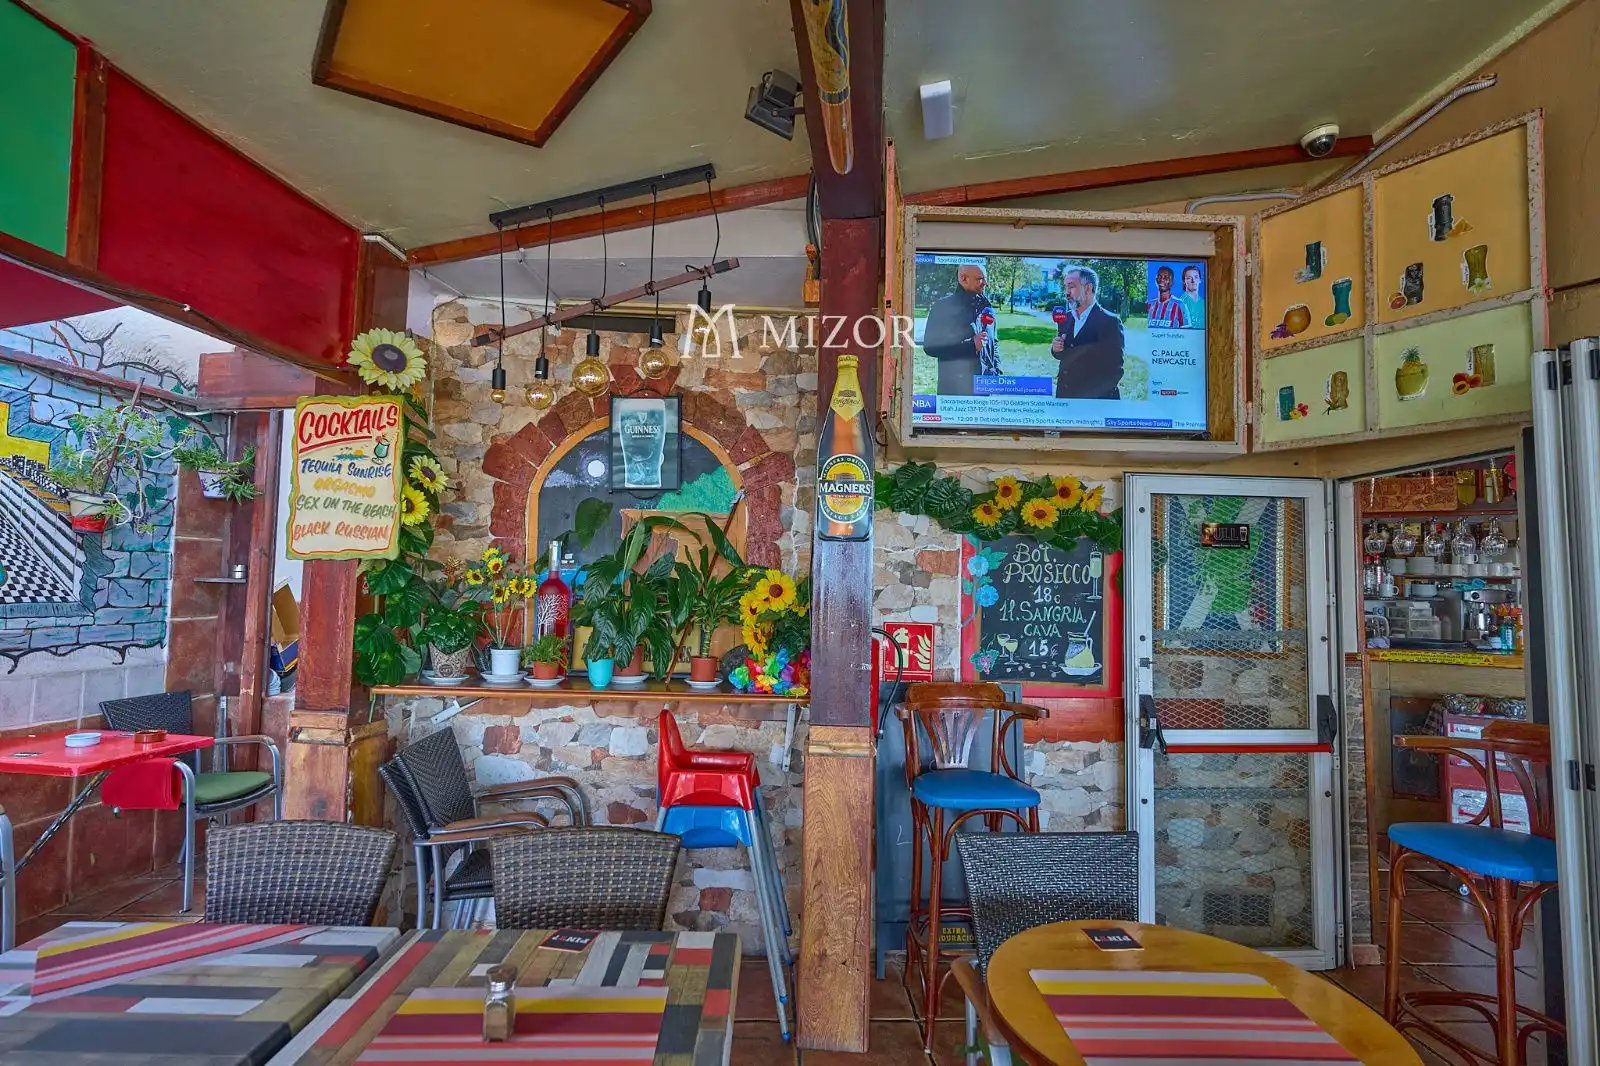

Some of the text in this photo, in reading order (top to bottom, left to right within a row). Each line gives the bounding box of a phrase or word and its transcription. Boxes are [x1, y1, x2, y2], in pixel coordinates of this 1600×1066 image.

[1152, 349, 1190, 358] C. PALACE
[1151, 357, 1197, 366] NEWCASTLE
[998, 377, 1016, 385] Dias
[912, 400, 931, 408] NBA
[299, 404, 398, 444] COCKTAILS
[624, 424, 661, 434] GUINNESS
[301, 458, 392, 479] TEQUILA SUNRISE
[819, 481, 871, 496] MAGNERS
[296, 494, 397, 520] SEX ON THE BEACH
[293, 520, 389, 542] BLACK RUSSIAN
[1204, 527, 1239, 541] PULL
[1002, 562, 1091, 584] PROSECCO
[1023, 623, 1062, 638] CAVA
[940, 934, 976, 942] DURACIO
